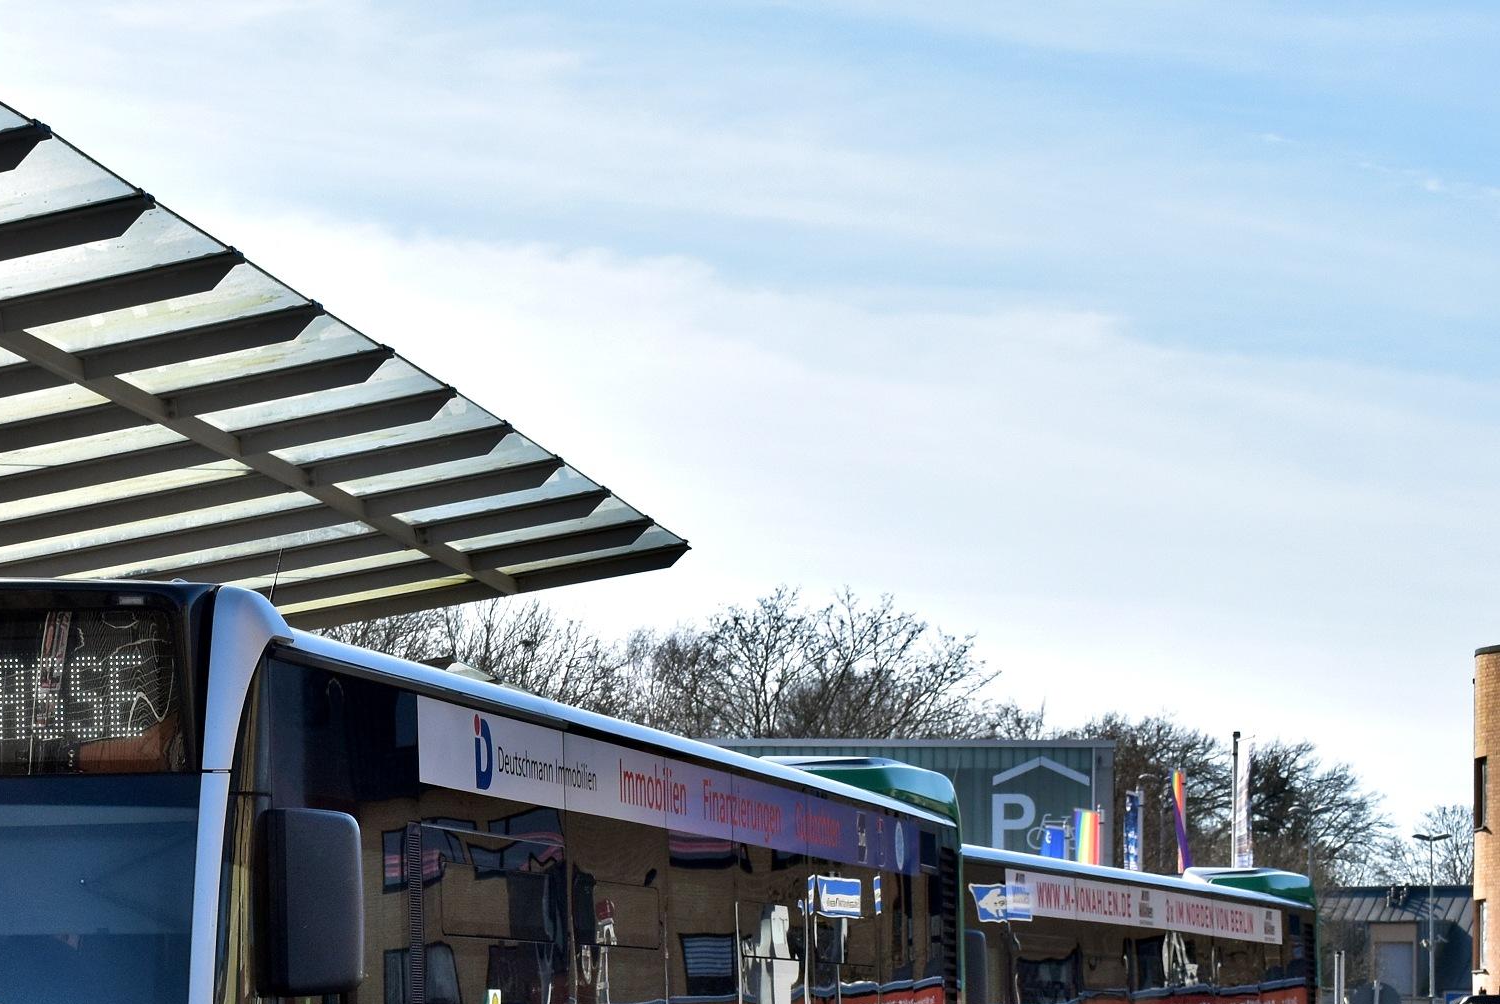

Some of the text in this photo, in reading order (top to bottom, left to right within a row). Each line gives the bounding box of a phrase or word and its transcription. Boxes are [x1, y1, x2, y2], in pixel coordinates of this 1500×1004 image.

[497, 746, 598, 792] Deutschmann Immobilien
[619, 758, 687, 816] Immobilien
[702, 778, 783, 843] Finanzierungen
[991, 793, 1036, 851] P
[1036, 881, 1133, 919] WWW.M-VONAHLEN.DE
[1185, 902, 1214, 930] NORDEN
[1215, 905, 1229, 931] VON
[1230, 909, 1254, 935] BERLIN
